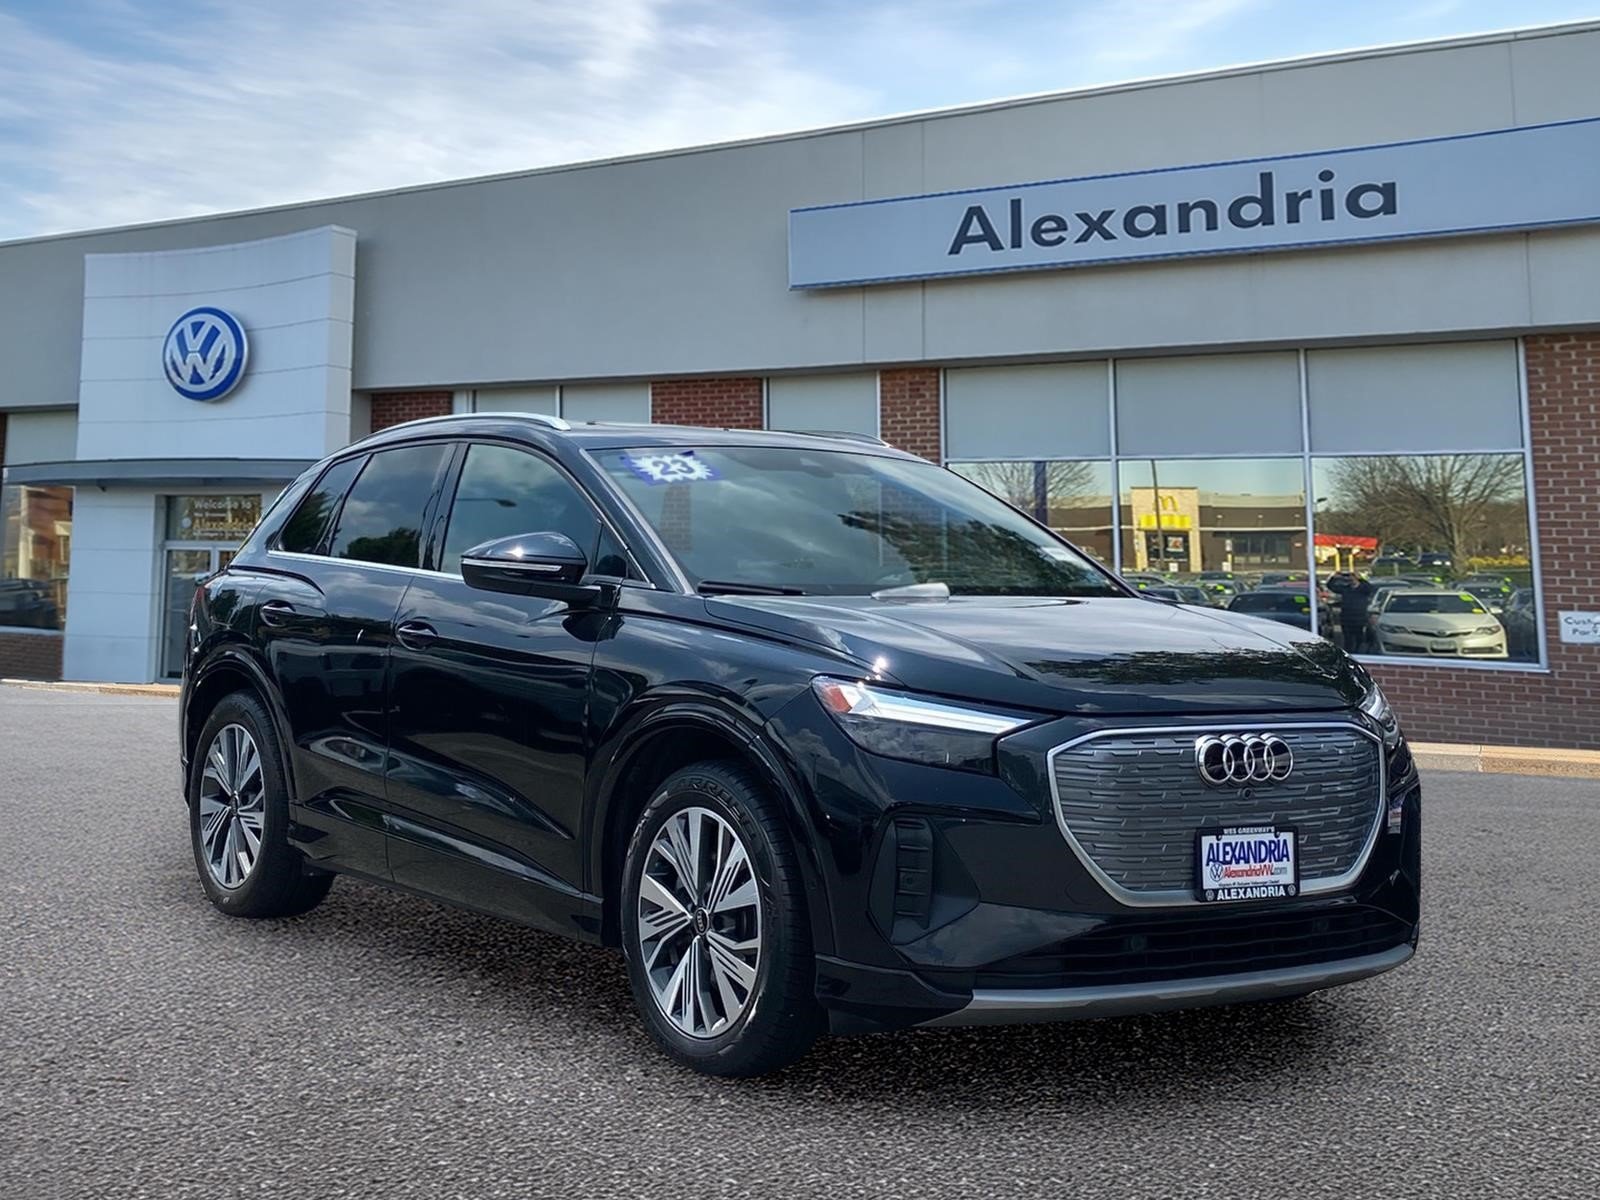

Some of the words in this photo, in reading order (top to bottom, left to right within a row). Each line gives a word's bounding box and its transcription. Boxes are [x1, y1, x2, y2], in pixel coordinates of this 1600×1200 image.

[948, 170, 1397, 256] Alexandria
[165, 312, 238, 393] VW
[652, 460, 695, 475] 23
[1206, 839, 1290, 866] ALEXANDRIA
[1217, 886, 1286, 900] ALEXANDRIA
